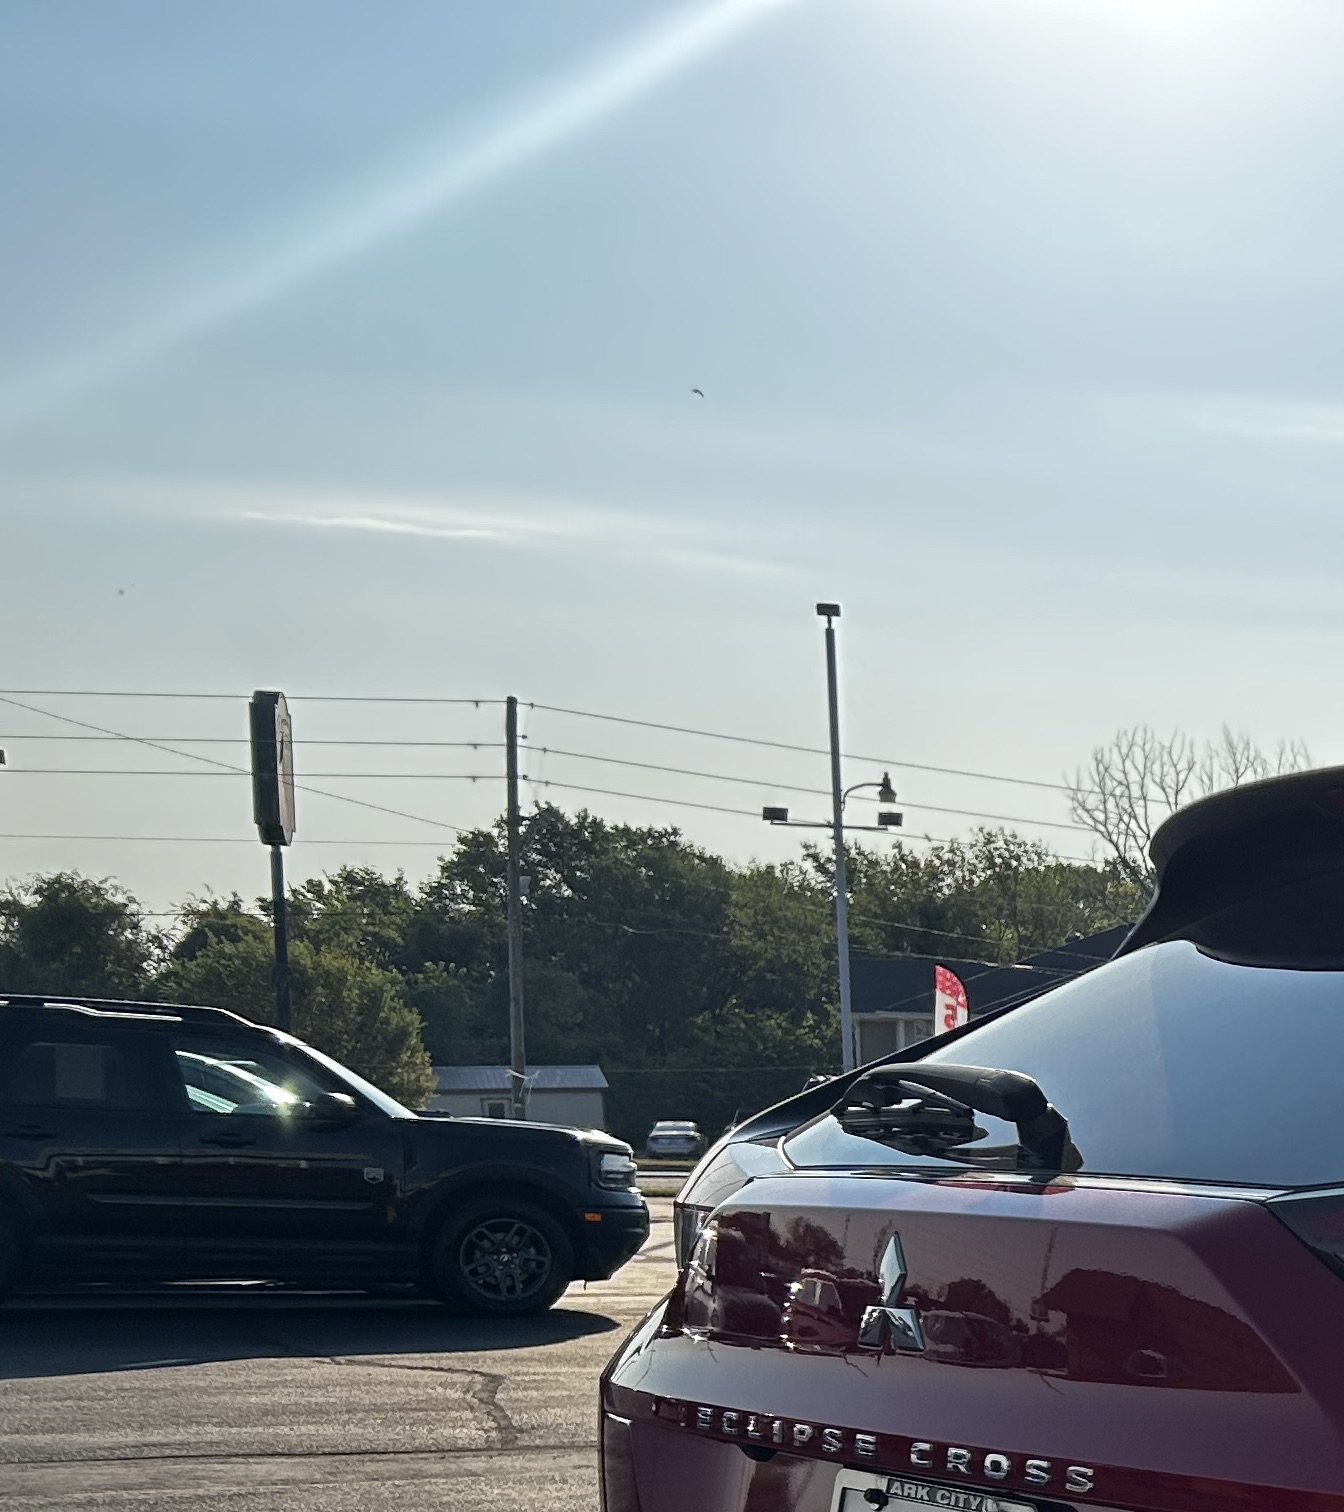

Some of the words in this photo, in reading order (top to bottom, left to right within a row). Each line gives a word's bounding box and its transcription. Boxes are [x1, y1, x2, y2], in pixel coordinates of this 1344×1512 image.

[696, 1406, 877, 1456] ECLIPSE
[910, 1442, 1095, 1493] CROSS
[889, 1481, 931, 1501] ARK
[936, 1489, 982, 1510] CITY
